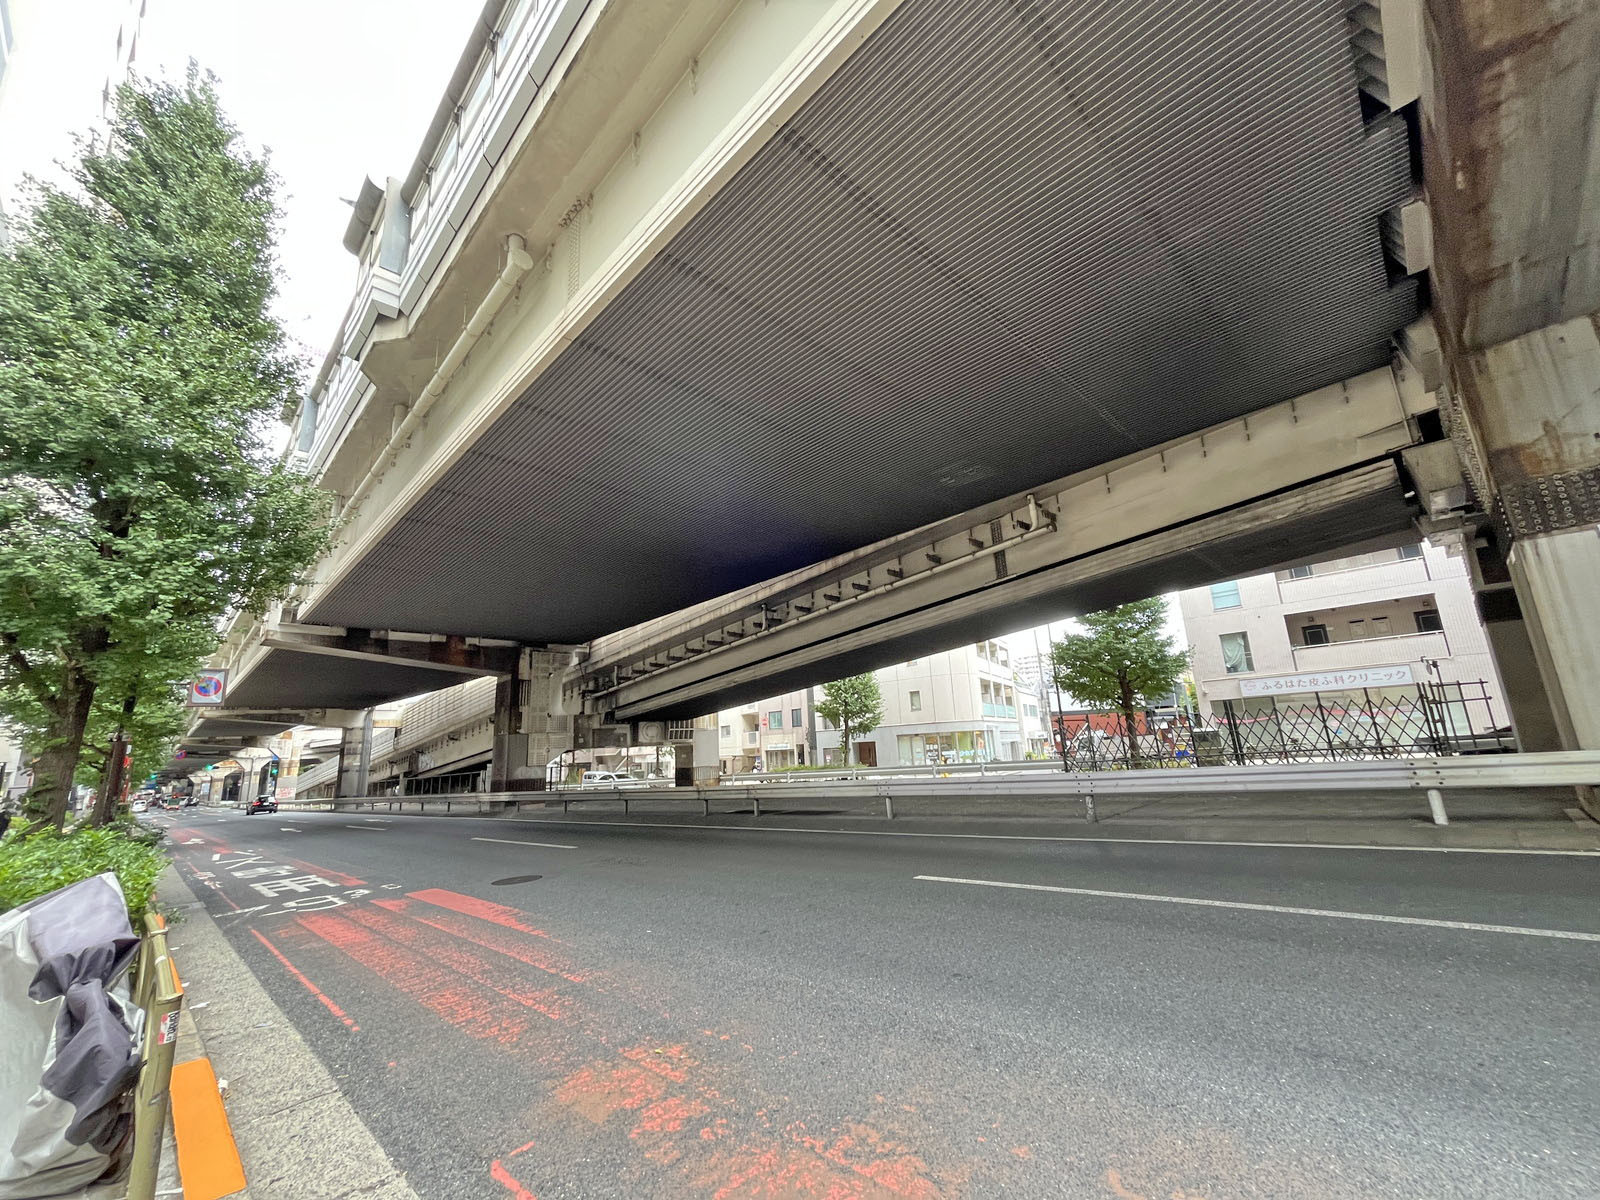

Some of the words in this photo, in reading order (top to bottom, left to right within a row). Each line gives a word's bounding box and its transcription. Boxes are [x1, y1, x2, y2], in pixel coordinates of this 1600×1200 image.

[1261, 670, 1406, 690] ふるはた皮ふ科クリニック
